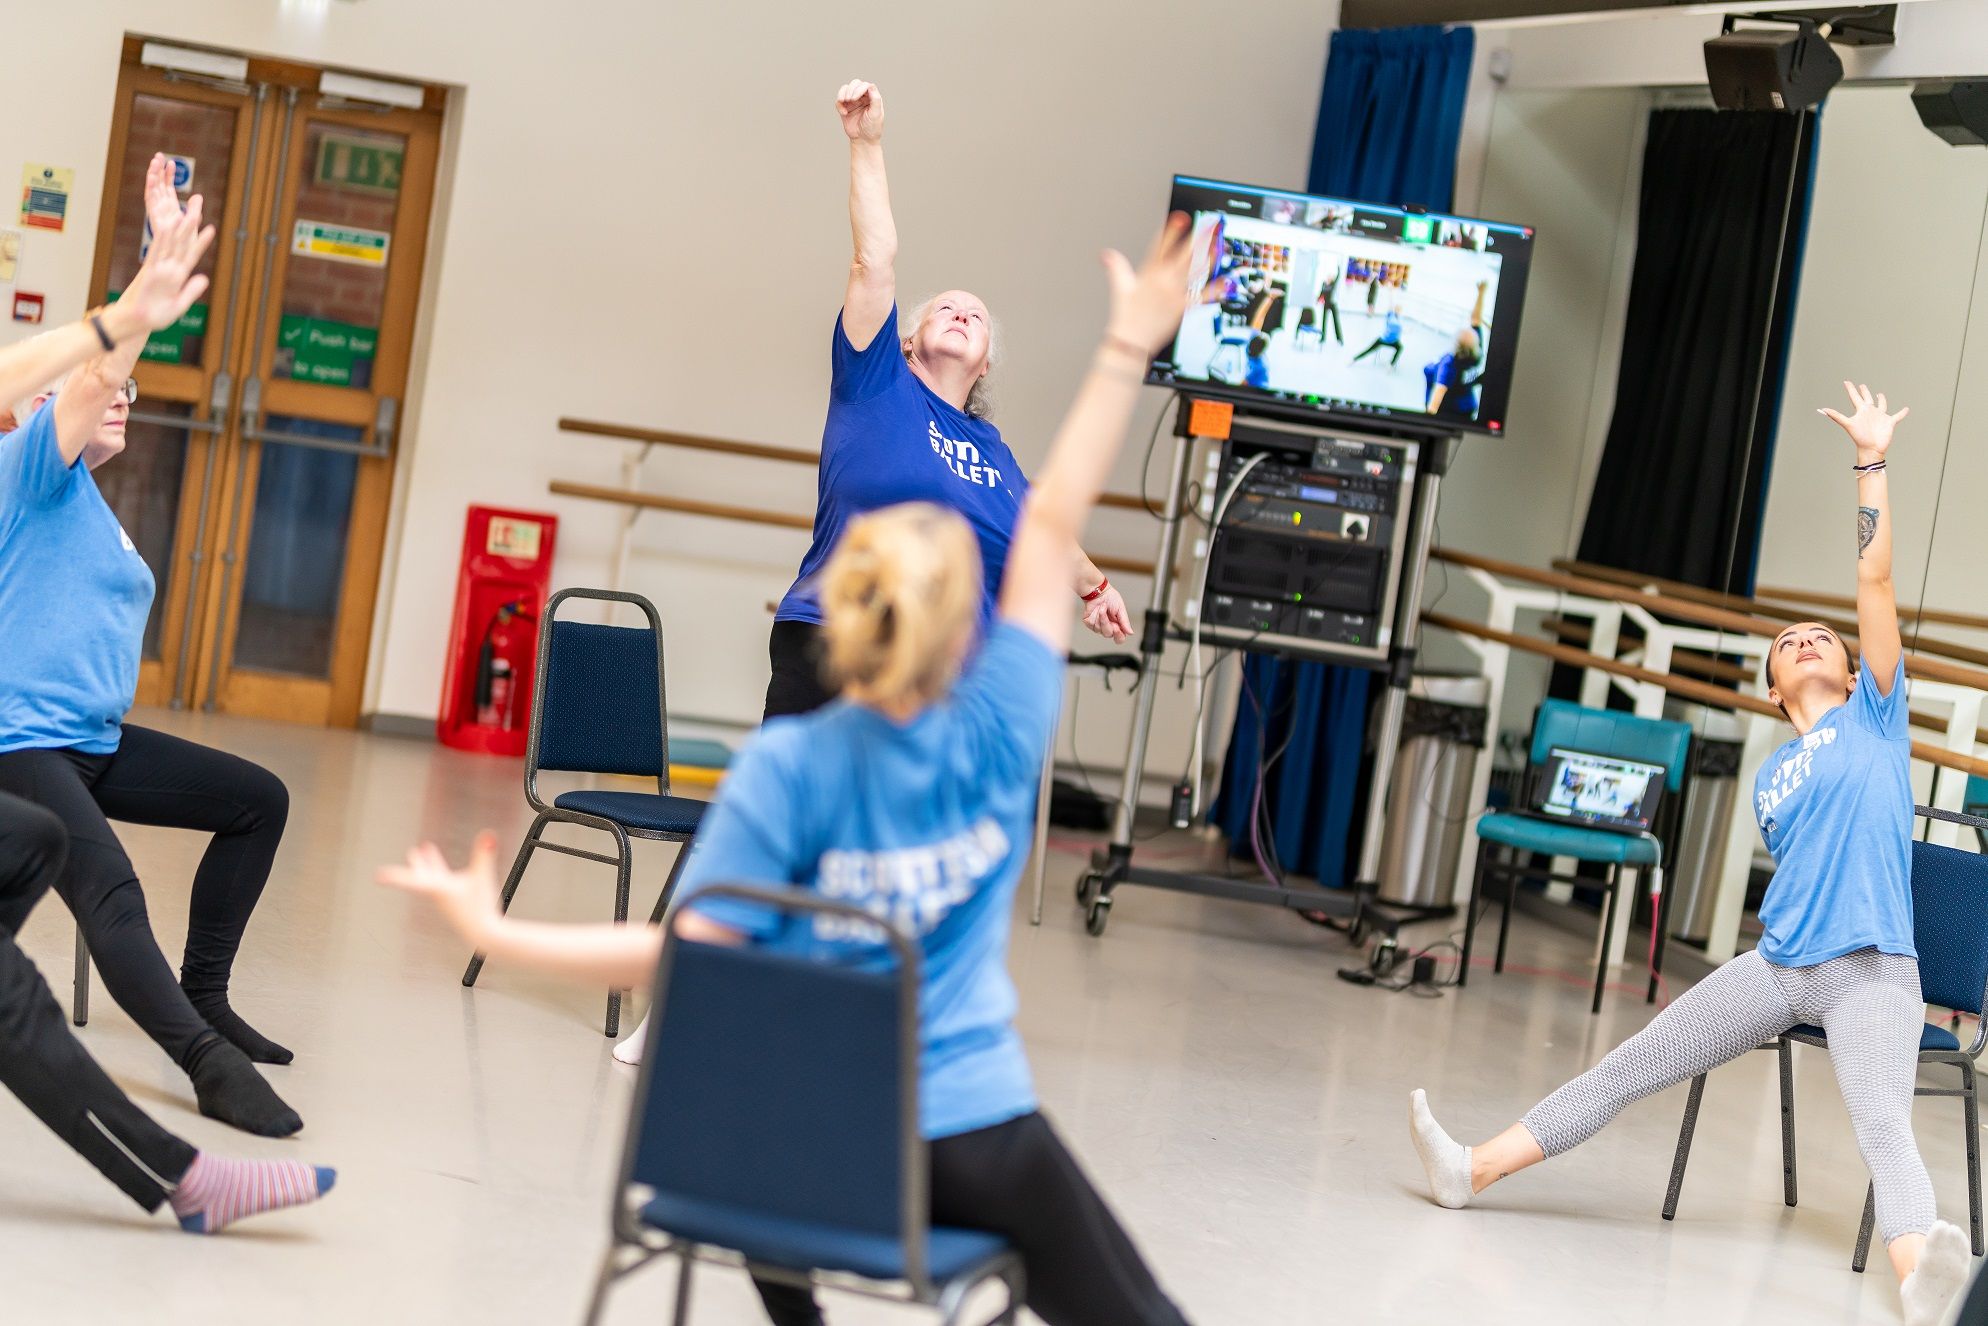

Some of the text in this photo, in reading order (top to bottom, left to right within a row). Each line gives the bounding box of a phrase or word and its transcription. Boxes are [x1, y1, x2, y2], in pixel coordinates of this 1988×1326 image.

[309, 328, 374, 352] Push bar
[312, 364, 350, 381] open
